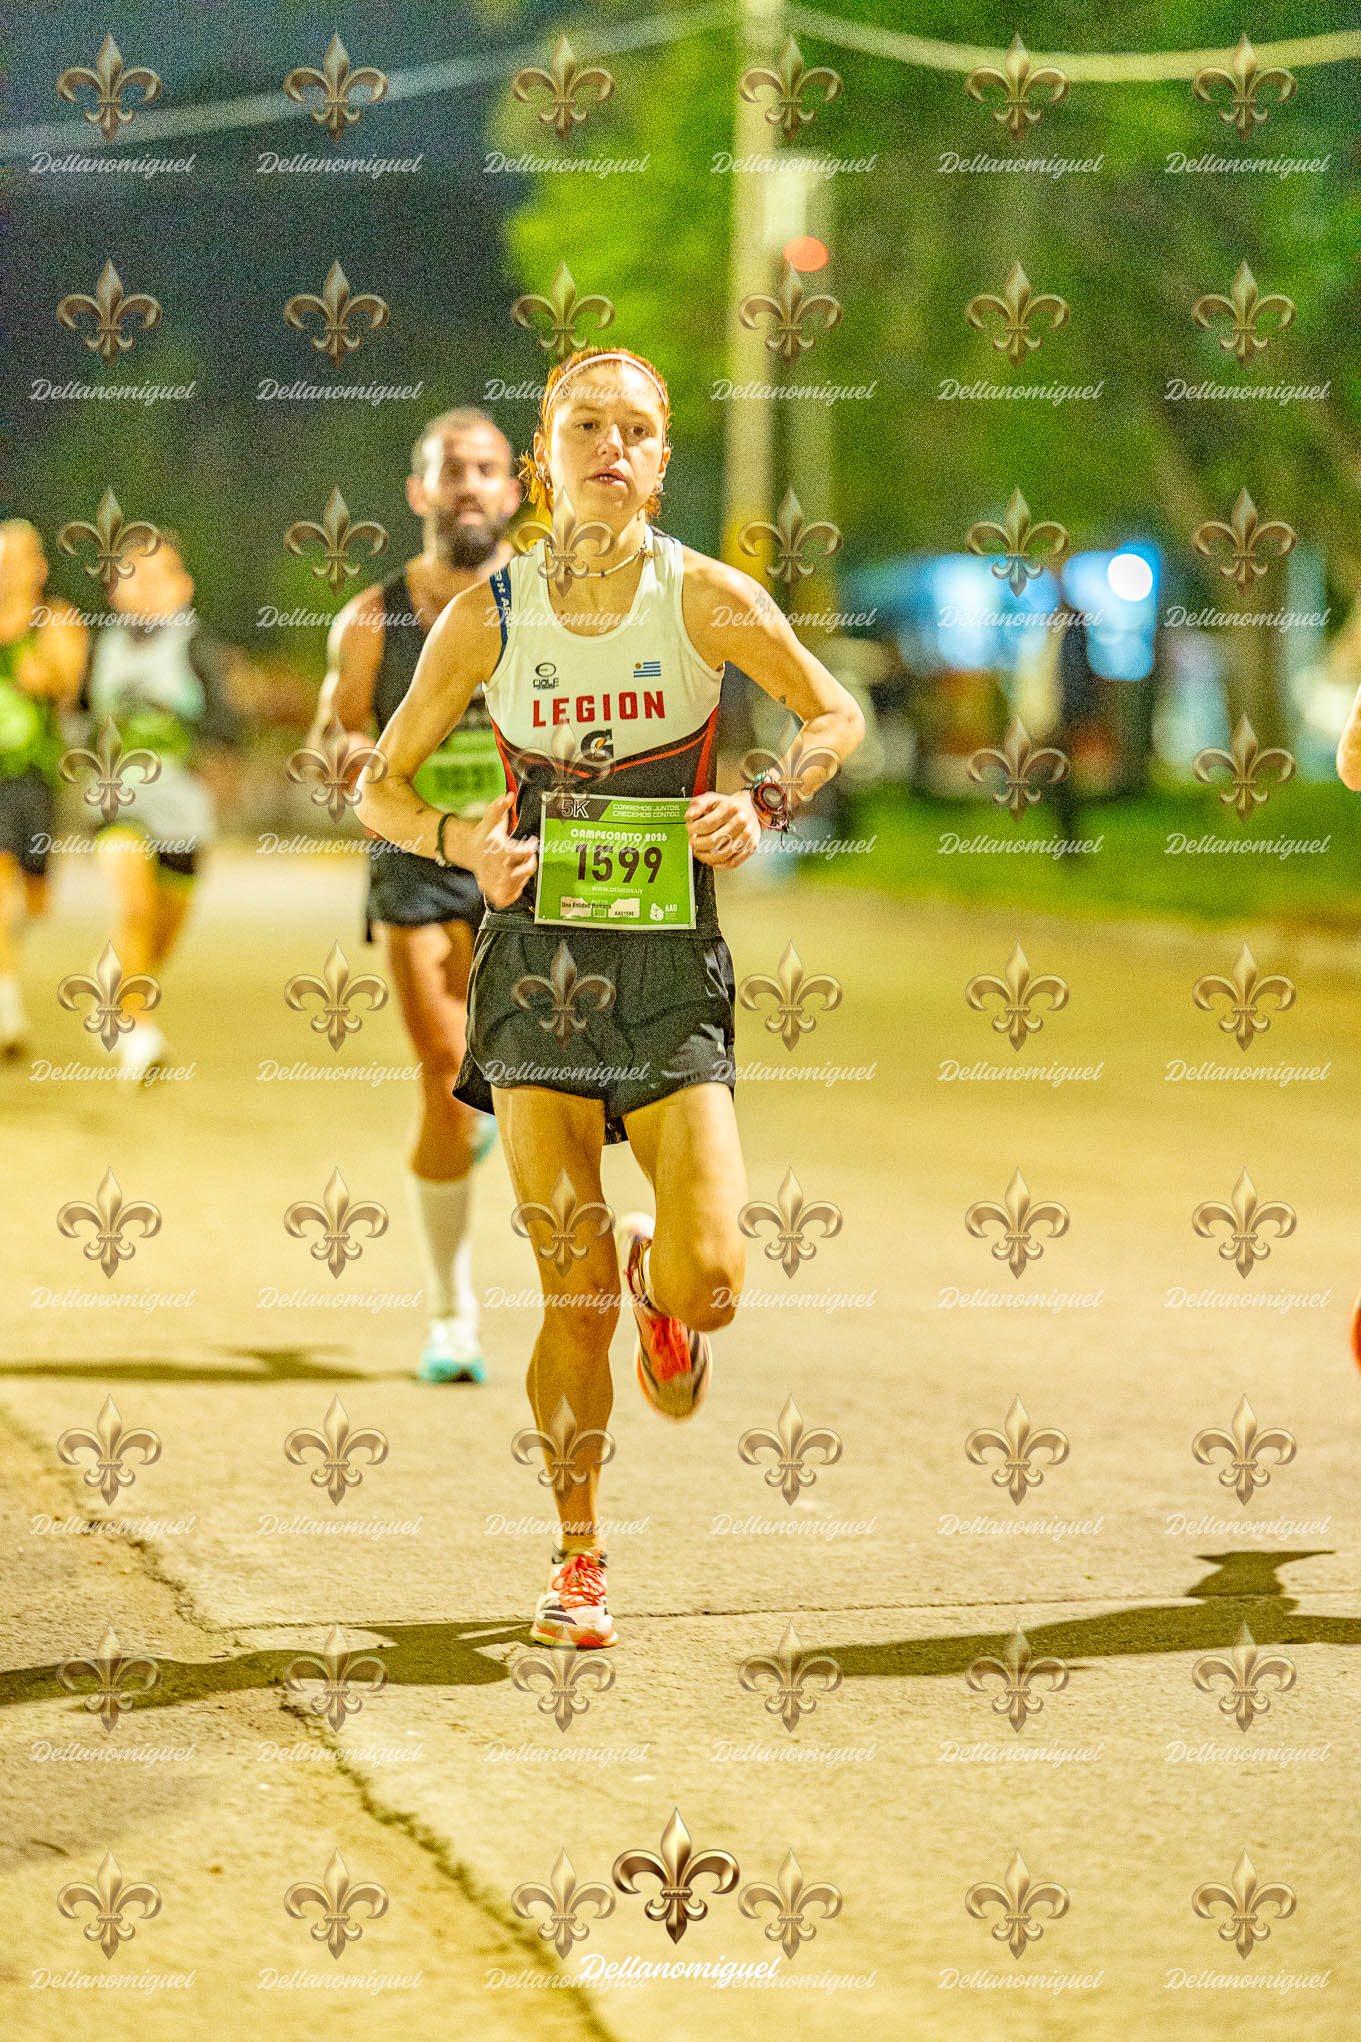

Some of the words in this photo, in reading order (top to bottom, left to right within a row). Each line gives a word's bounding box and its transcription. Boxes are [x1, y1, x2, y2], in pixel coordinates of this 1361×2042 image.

[533, 691, 666, 728] LEGION
[561, 799, 590, 819] 5K
[570, 828, 643, 842] CAMPEONATO
[645, 833, 668, 842] 2026
[575, 844, 662, 884] 1599
